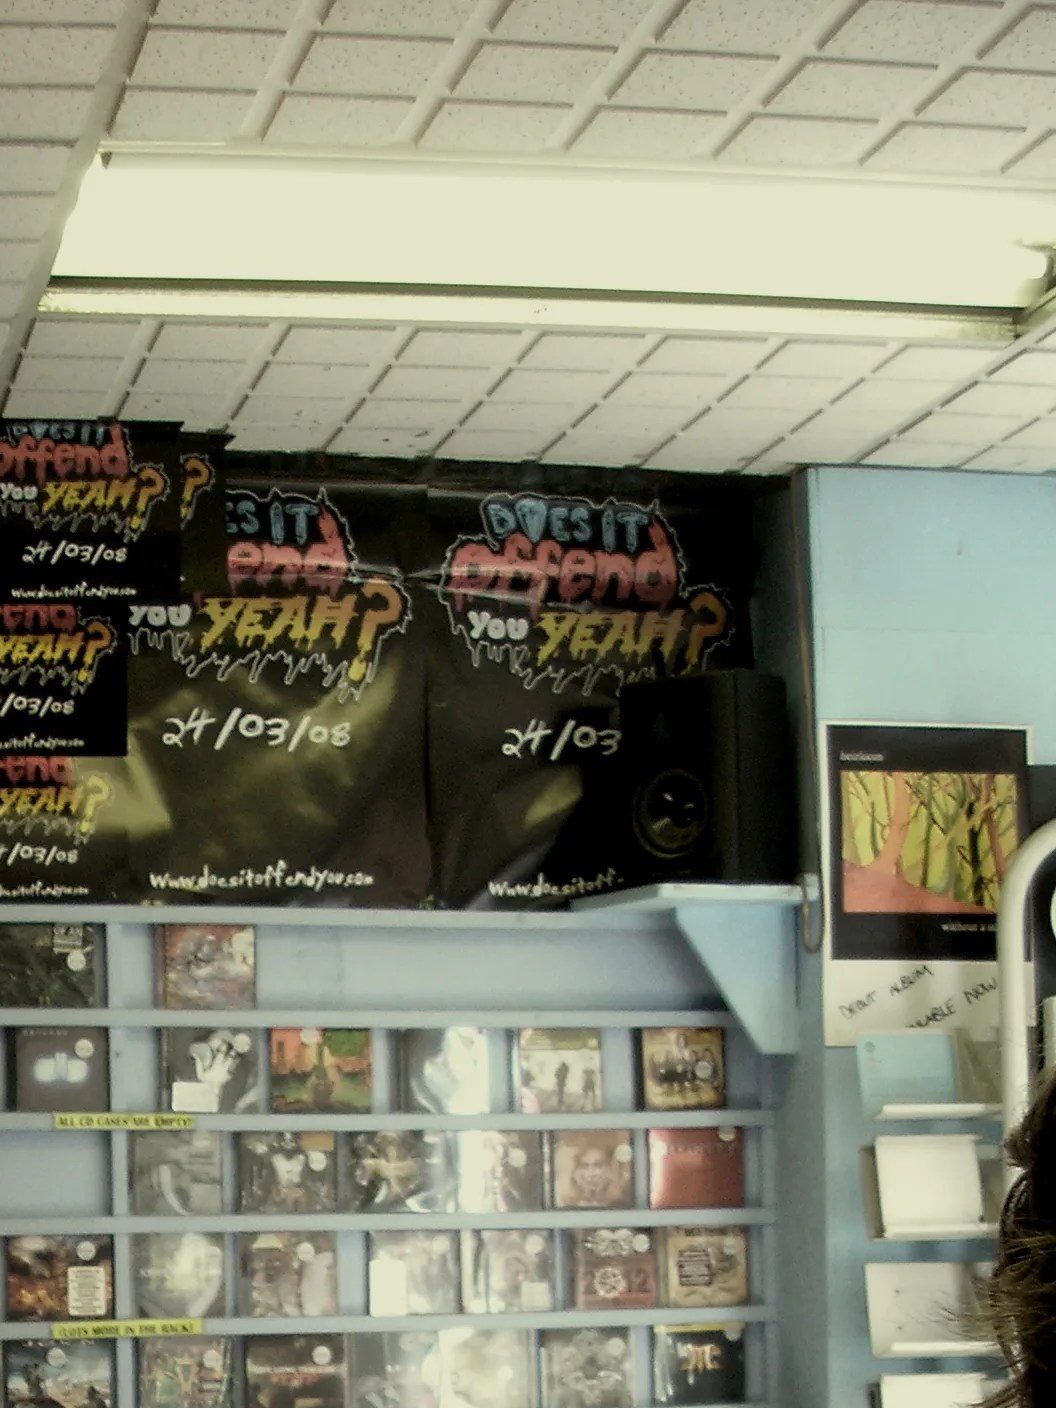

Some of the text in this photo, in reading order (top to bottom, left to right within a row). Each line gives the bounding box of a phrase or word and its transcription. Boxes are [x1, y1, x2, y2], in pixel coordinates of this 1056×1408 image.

[43, 467, 164, 529] YEAH?
[21, 540, 128, 565] 24/03/08
[601, 507, 649, 553] IT
[447, 516, 677, 606] offend
[199, 577, 403, 681] YEAH?
[161, 707, 352, 752] 24/03/08
